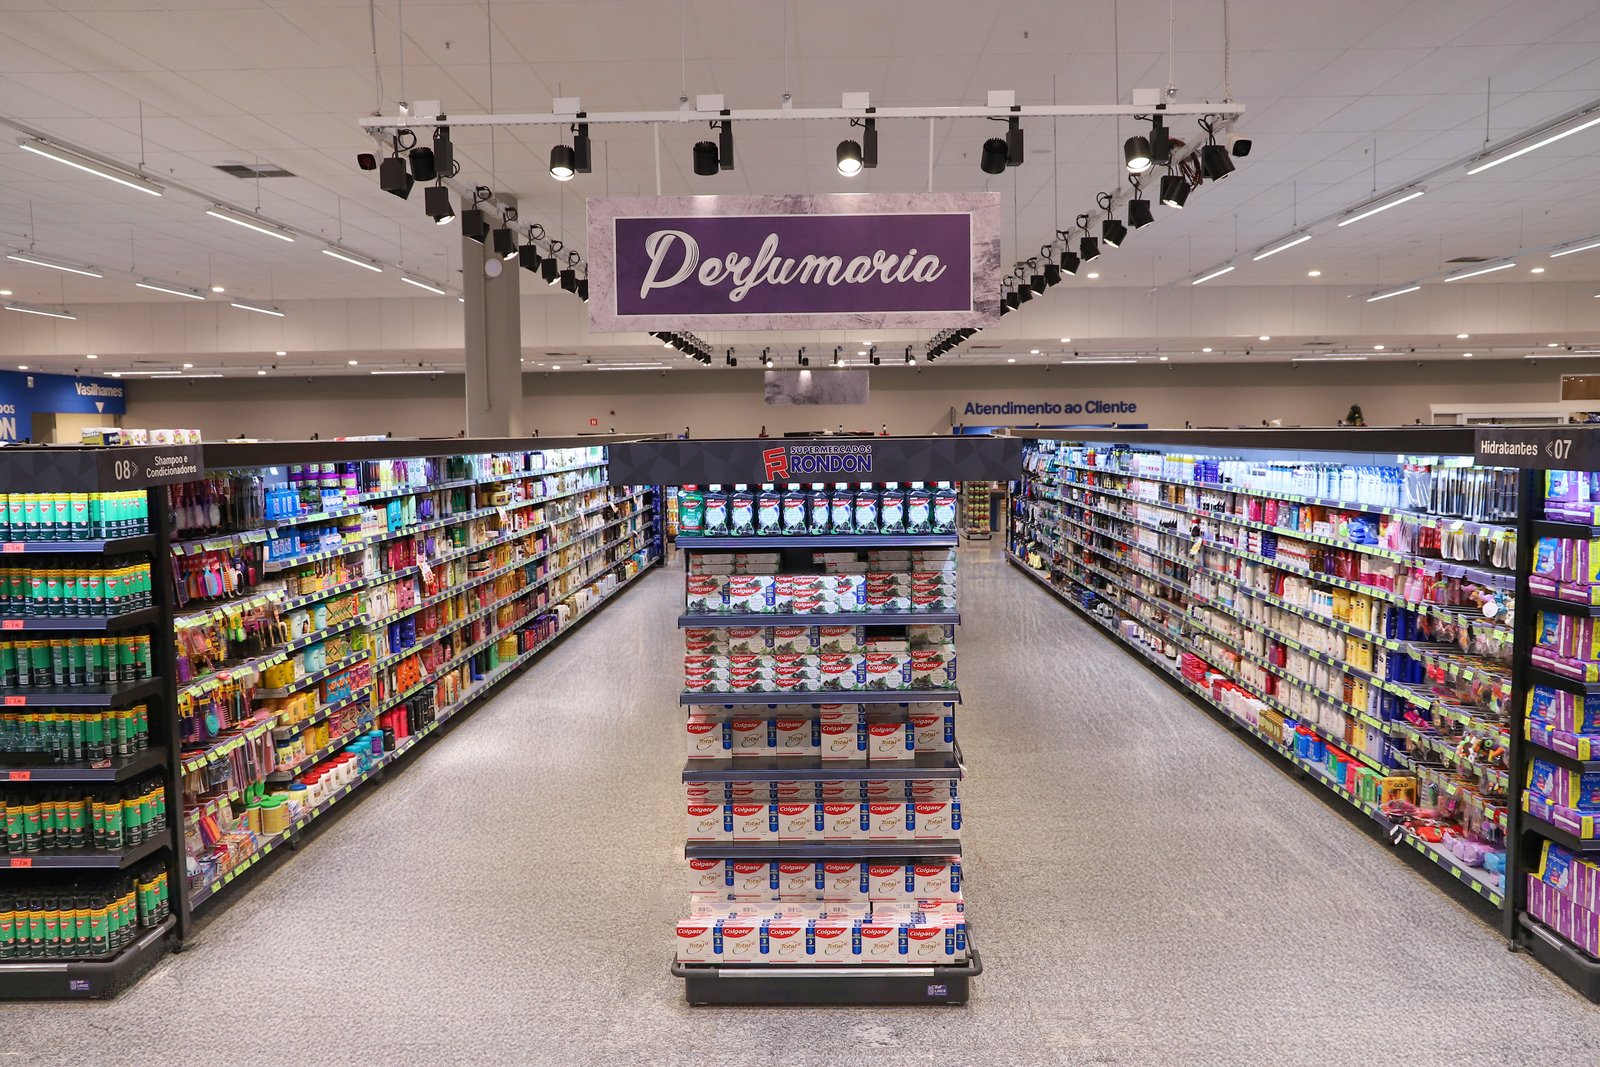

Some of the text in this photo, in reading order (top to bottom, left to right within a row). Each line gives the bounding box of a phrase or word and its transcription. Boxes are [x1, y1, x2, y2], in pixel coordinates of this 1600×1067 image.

[641, 230, 947, 302] Perfumaria
[75, 382, 123, 397] Vasilhames
[964, 401, 1137, 415] Atendimento ao Cliente
[790, 445, 872, 454] SUPERMERCADOS
[1481, 441, 1538, 455] Hidratantes
[1554, 439, 1572, 459] 07
[154, 455, 188, 467] Shampoo e
[790, 455, 872, 473] RONDON
[115, 460, 131, 480] 08
[146, 464, 197, 478] Condicionadores
